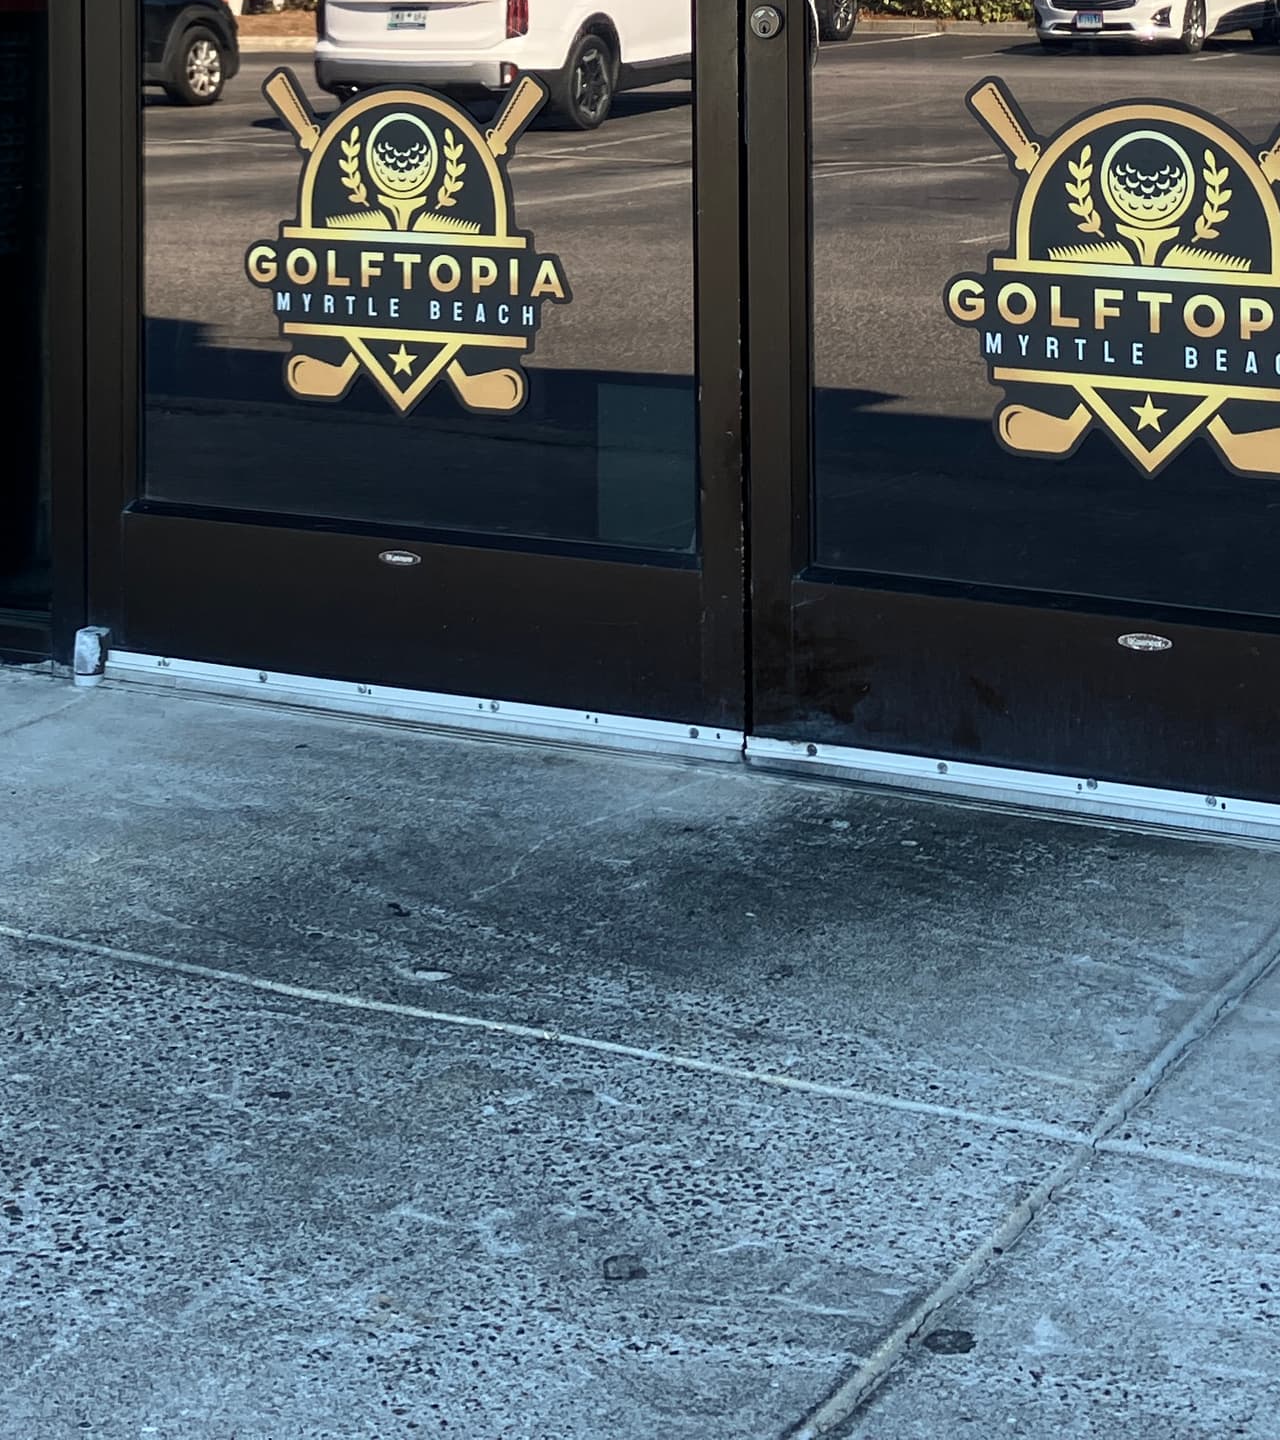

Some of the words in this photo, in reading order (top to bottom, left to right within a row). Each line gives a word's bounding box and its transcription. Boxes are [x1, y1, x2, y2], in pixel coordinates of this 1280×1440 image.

[247, 243, 566, 299] GOLFTOPIA
[276, 291, 401, 318] MYRTLE
[428, 302, 535, 326] BEACH
[985, 331, 1145, 366] MYRTLE
